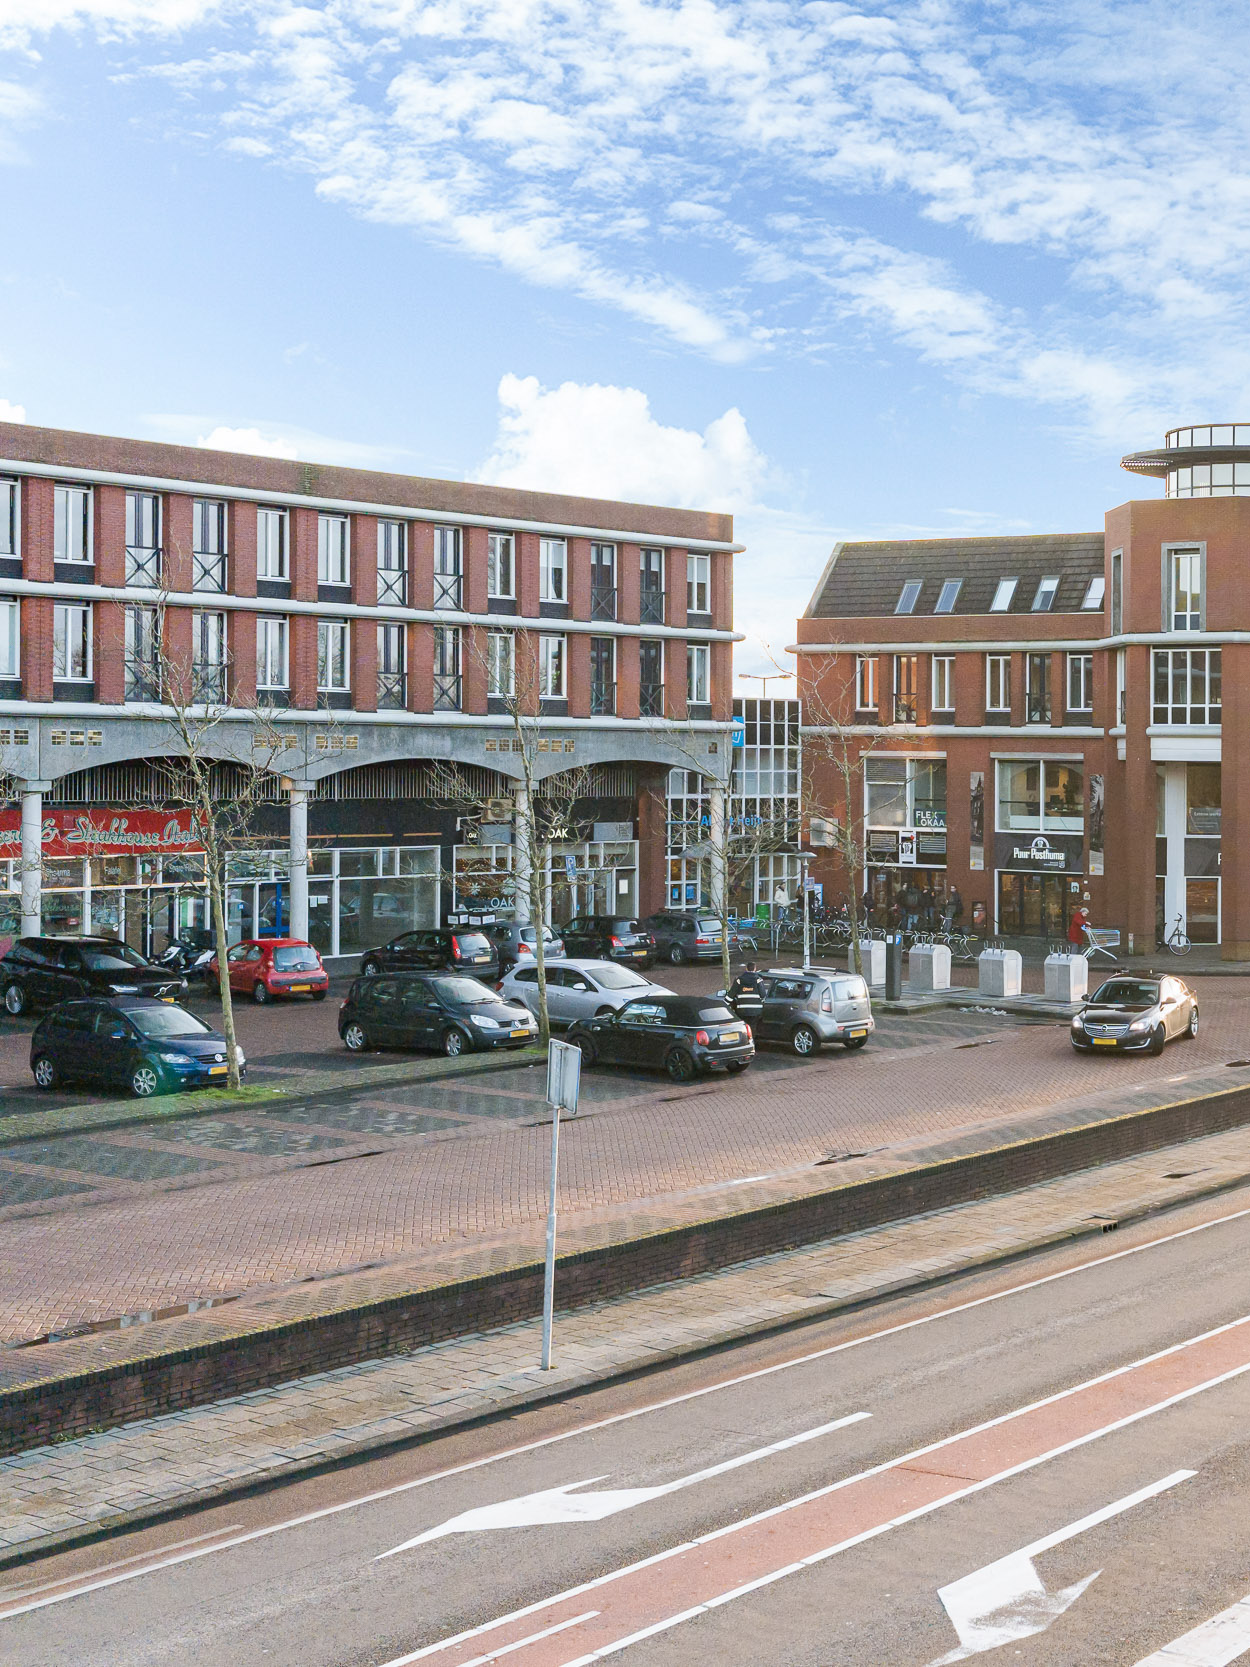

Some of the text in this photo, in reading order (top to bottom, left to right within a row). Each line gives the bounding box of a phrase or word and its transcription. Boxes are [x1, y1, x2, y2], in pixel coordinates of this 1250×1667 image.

[915, 811, 938, 819] FLEX
[66, 816, 160, 847] Steakhouse
[547, 827, 569, 839] OAK
[1013, 847, 1065, 860] Puur Posthuma
[490, 896, 516, 908] OAK
